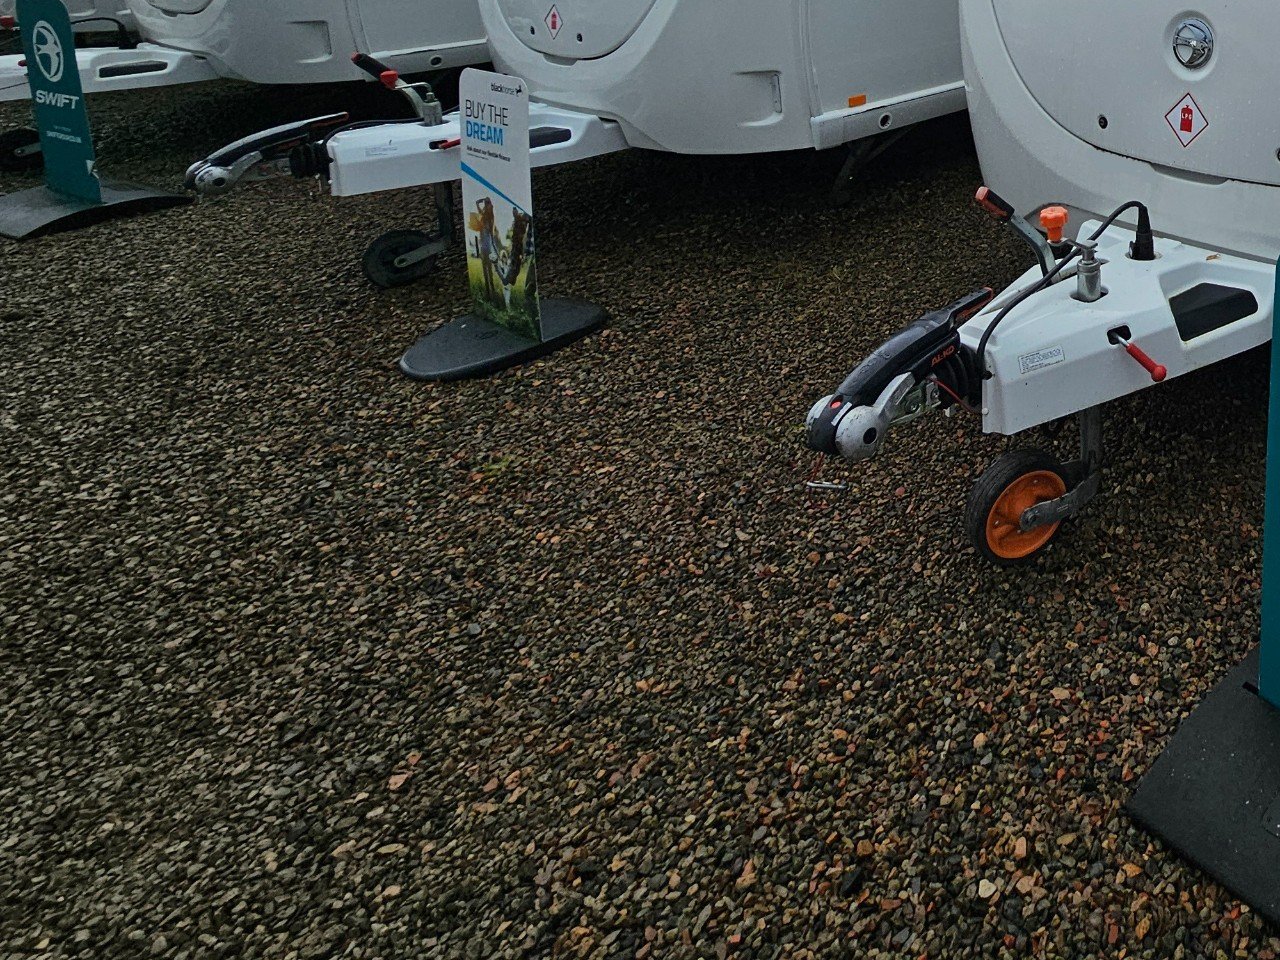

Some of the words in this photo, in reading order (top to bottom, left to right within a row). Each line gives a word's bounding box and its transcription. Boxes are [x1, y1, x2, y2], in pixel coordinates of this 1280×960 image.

[36, 89, 80, 110] SWIFT
[465, 99, 487, 121] BUY
[487, 104, 509, 127] THE
[465, 120, 504, 146] DREAM
